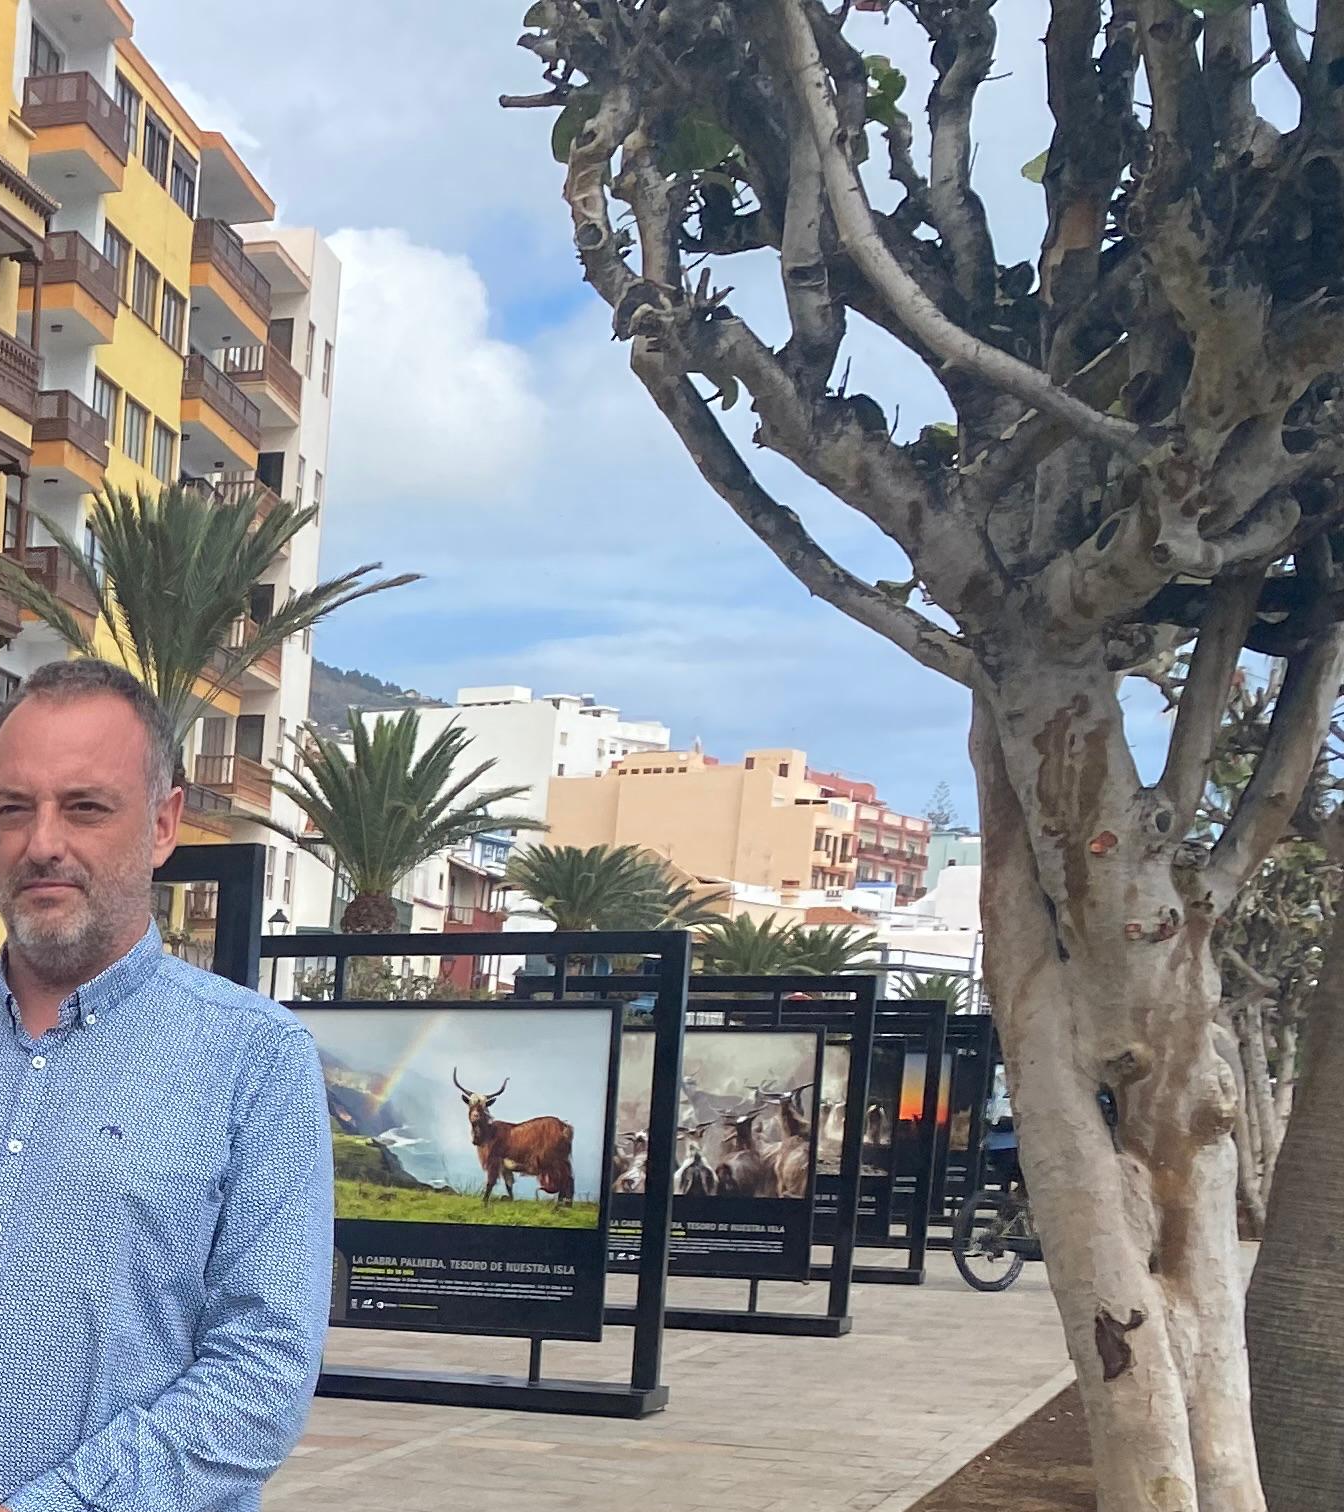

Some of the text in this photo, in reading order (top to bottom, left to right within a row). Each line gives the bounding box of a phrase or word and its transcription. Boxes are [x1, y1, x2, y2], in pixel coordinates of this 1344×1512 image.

[353, 1255, 363, 1265] LA
[365, 1255, 398, 1267] CABRA
[450, 1259, 488, 1270] TESORO
[490, 1261, 503, 1272] DE
[506, 1262, 551, 1273] NUESTRA
[553, 1265, 575, 1275] ISLA
